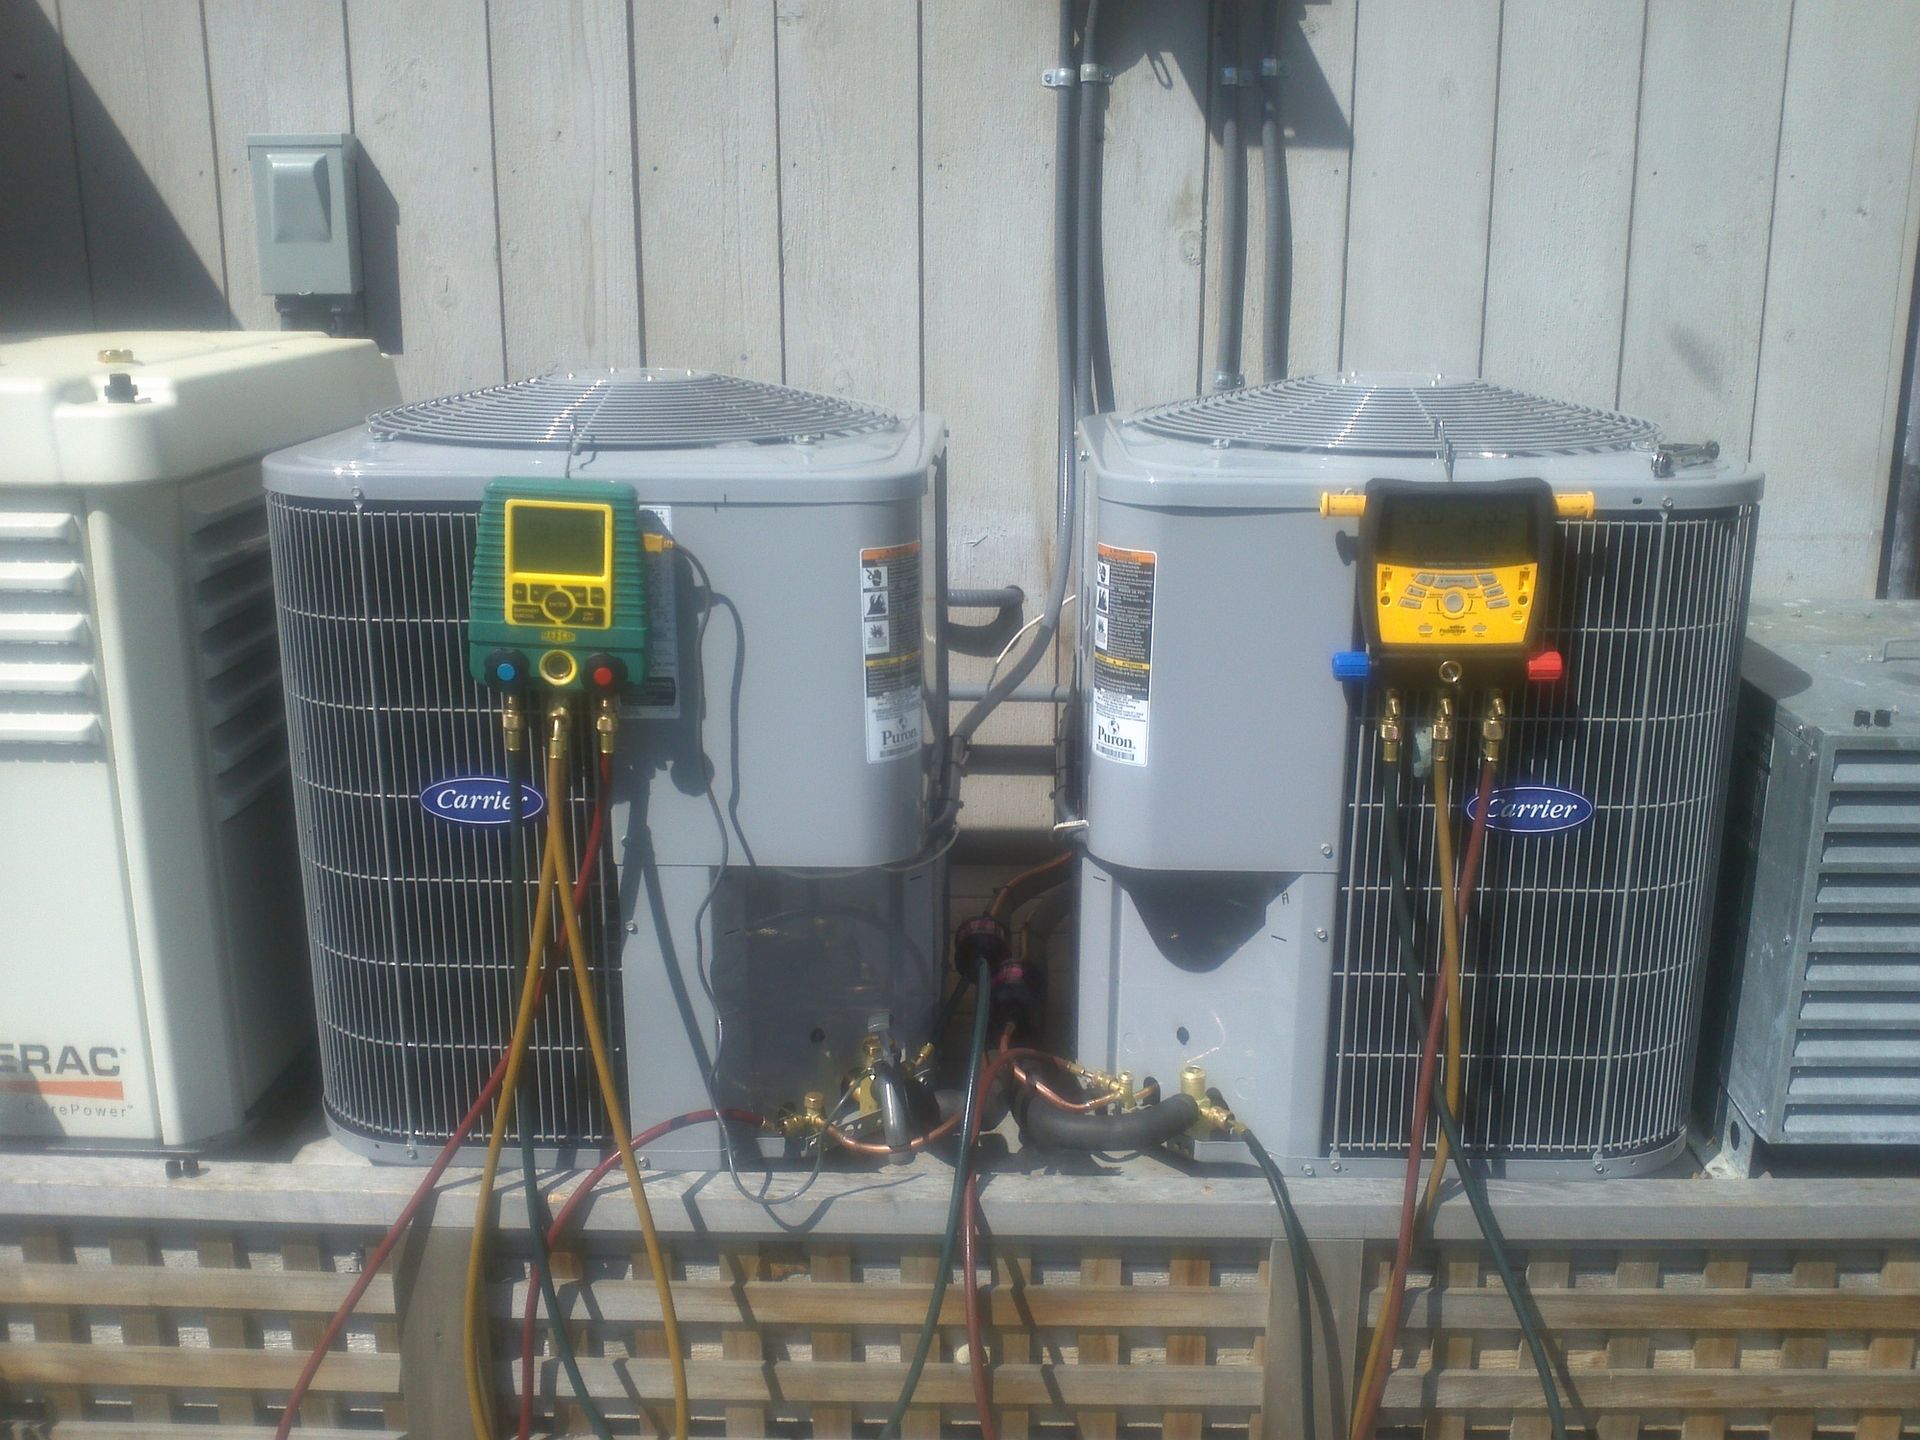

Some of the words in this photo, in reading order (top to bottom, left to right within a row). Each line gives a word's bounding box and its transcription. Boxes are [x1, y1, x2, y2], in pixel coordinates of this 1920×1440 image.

[882, 727, 918, 746] Puron
[1098, 725, 1133, 749] Puron
[1486, 798, 1578, 819] Carrier
